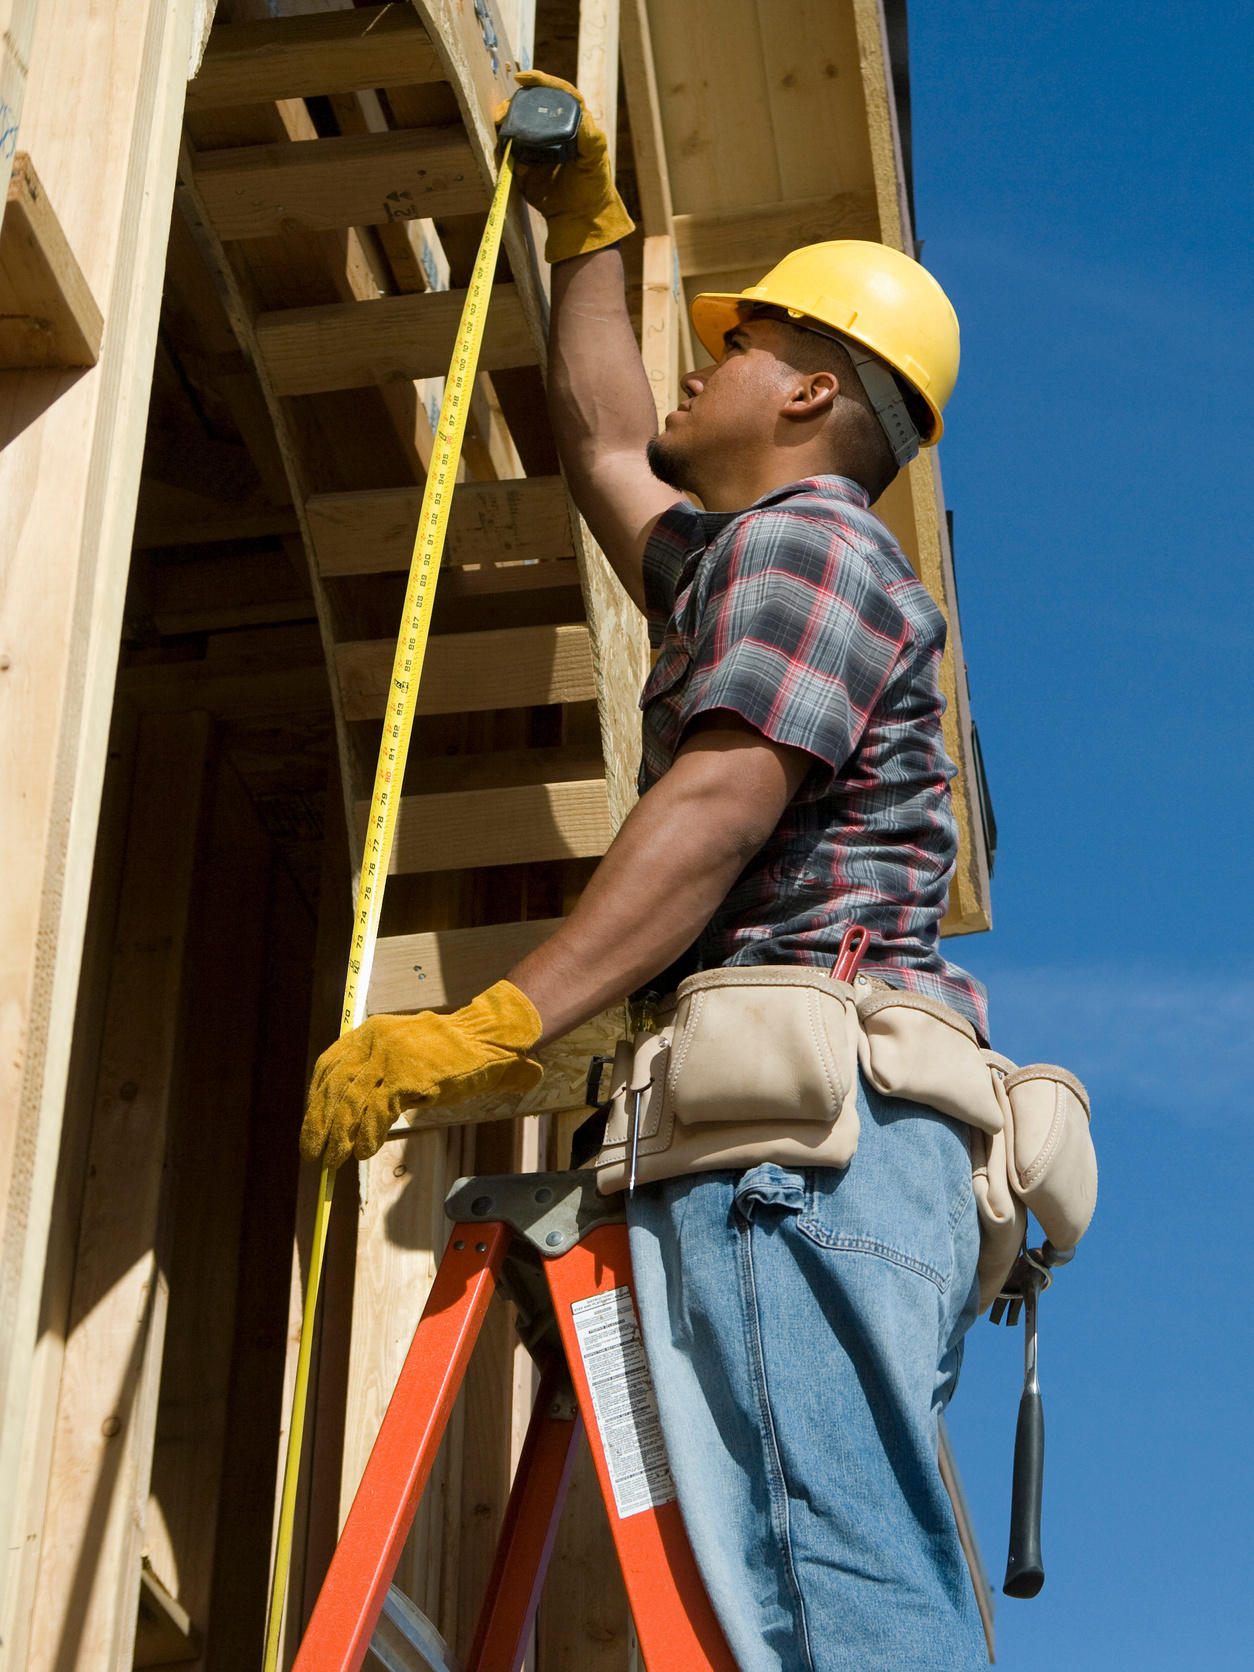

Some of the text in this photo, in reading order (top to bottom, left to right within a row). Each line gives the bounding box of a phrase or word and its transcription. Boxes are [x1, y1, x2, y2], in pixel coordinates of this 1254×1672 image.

[456, 377, 462, 388] 99
[452, 396, 459, 407] 98
[449, 415, 456, 426] 97
[442, 454, 448, 465] 95
[438, 473, 445, 484] 94
[435, 493, 441, 505] 93
[431, 513, 438, 525] 92
[427, 534, 434, 545] 91
[424, 554, 430, 566] 90
[420, 575, 427, 586] 89
[416, 595, 423, 608] 88
[412, 617, 419, 629] 87
[408, 638, 415, 650] 86
[405, 660, 411, 672] 85
[397, 703, 404, 715] 83
[393, 725, 400, 738] 82
[389, 748, 395, 760] 81
[385, 771, 391, 783] 80
[381, 793, 387, 805] 79
[377, 816, 384, 828] 78
[373, 839, 379, 852] 77
[369, 863, 375, 876] 76
[364, 887, 371, 900] 75
[360, 911, 367, 924] 74
[356, 935, 363, 948] 73
[348, 986, 354, 998] 71
[344, 1010, 350, 1023] 70
